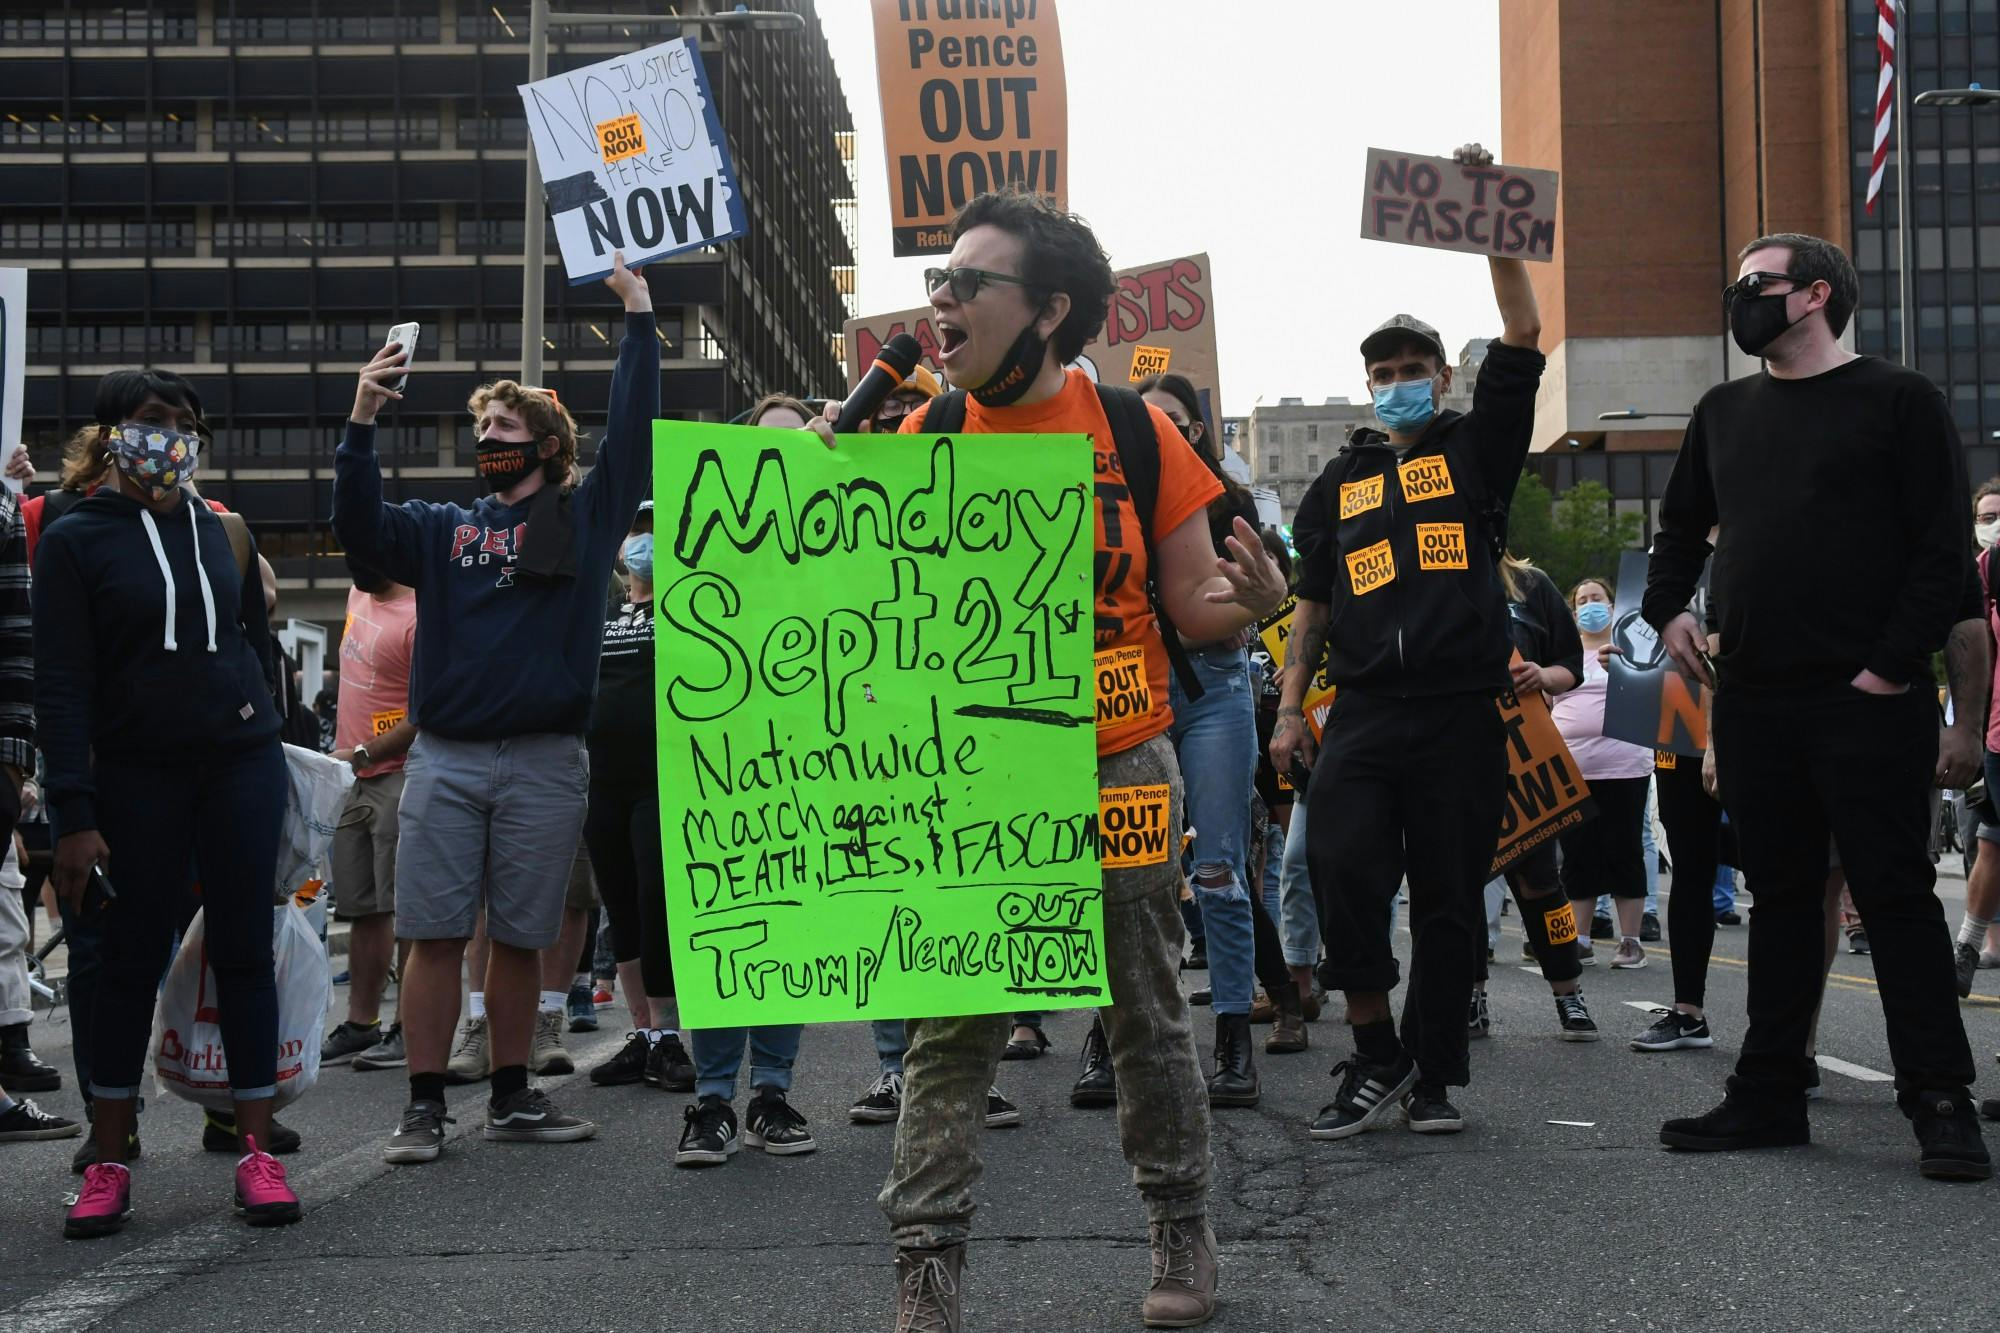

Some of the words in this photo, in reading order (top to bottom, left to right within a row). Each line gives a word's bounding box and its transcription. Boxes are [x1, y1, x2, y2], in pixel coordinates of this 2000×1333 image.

[908, 28, 1037, 69] Pence
[609, 48, 691, 93] JUSTICE
[629, 88, 696, 152] NO
[919, 77, 1037, 143] OUT
[603, 134, 642, 157] NOW
[604, 123, 635, 143] OUT
[603, 151, 674, 191] PEACE
[899, 149, 1057, 218] NOW!
[1374, 157, 1442, 199] NO
[1462, 168, 1536, 208] TO
[582, 177, 715, 257] NOW
[1372, 196, 1556, 255] FASCISM
[1138, 355, 1165, 368] OUT
[1405, 477, 1449, 497] NOW
[1406, 465, 1442, 482] OUT
[1343, 495, 1381, 516] NOW
[1346, 484, 1379, 503] OUT
[674, 437, 1086, 609] Monday
[1421, 549, 1464, 564] NOW
[1424, 534, 1459, 549] OUT
[461, 553, 490, 567] GO
[1354, 551, 1387, 576] OUT
[1354, 562, 1393, 590] NOW
[661, 557, 945, 737] Sept.
[953, 577, 1086, 706] 21st
[1094, 648, 1142, 667] rump/Pence
[1098, 664, 1140, 695] OUT
[1096, 687, 1149, 722] NOW
[689, 696, 985, 800] Nationwide
[1099, 788, 1168, 803] rump/Pence
[1104, 804, 1162, 832] OUT
[1100, 828, 1166, 858] NOW
[1489, 809, 1583, 873] efuseFascism.org
[996, 889, 1101, 926] OUT
[1550, 912, 1572, 929] OUT
[1550, 922, 1576, 940] NOW
[689, 905, 1004, 1009] Trump/Pence
[1008, 930, 1098, 987] NOW
